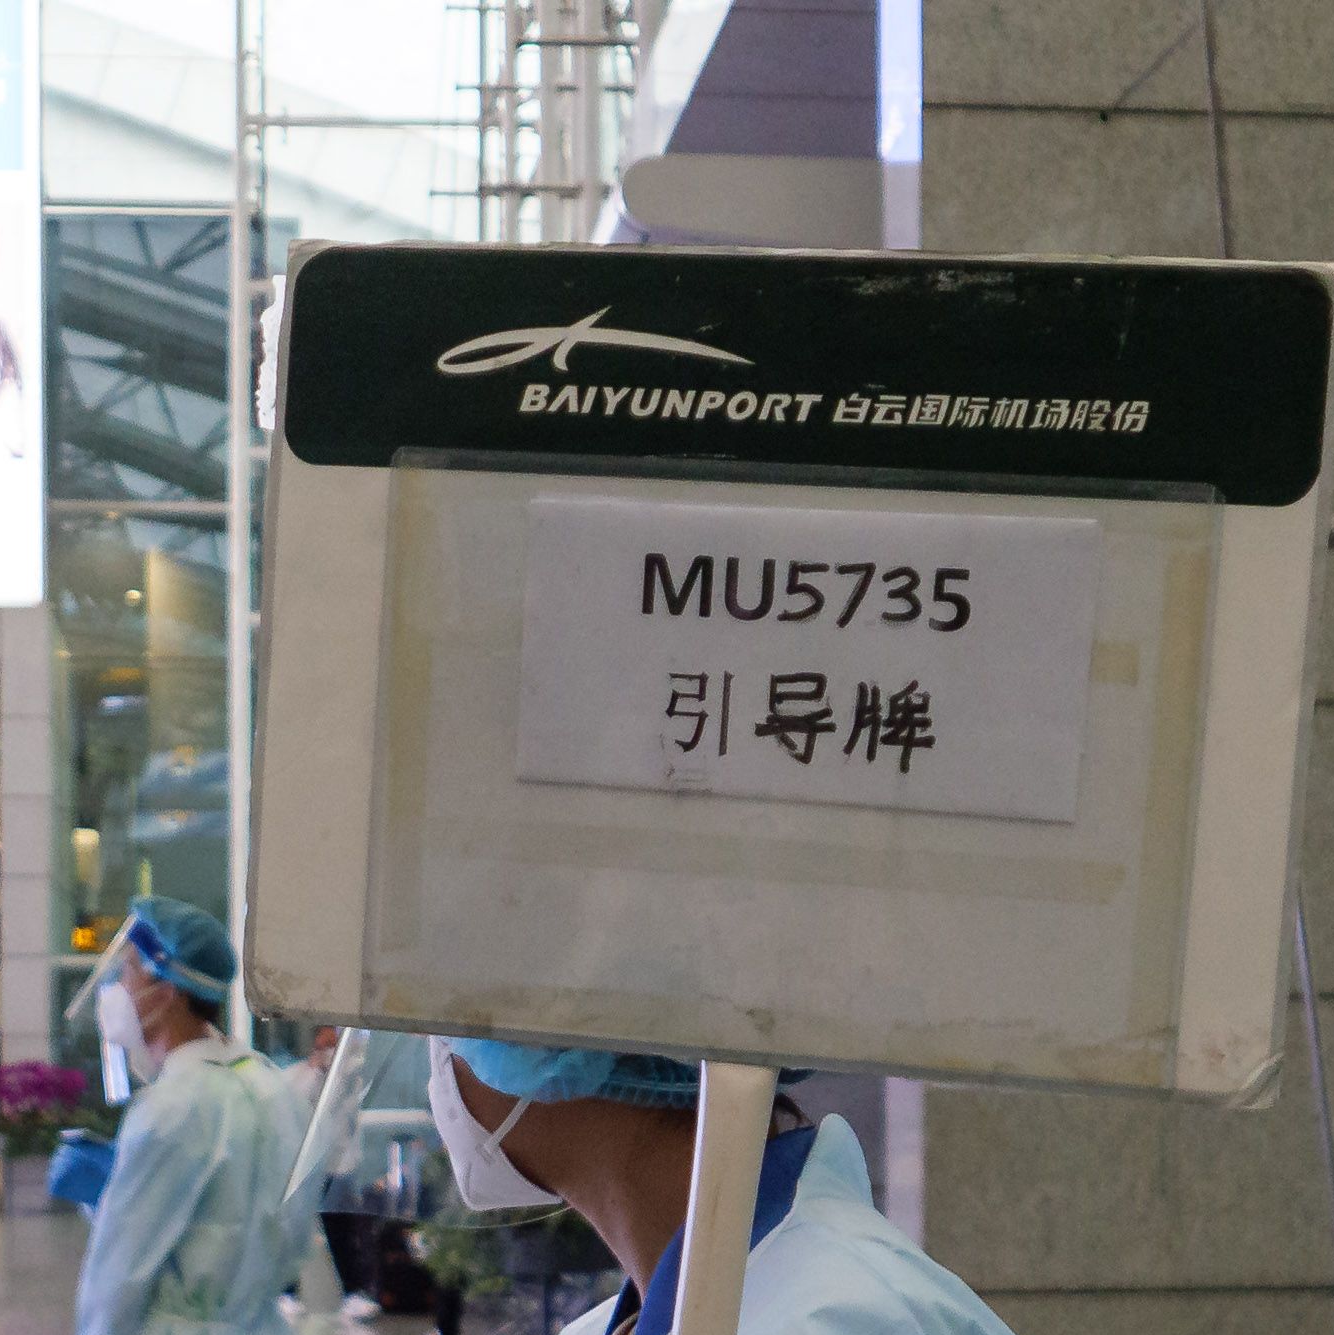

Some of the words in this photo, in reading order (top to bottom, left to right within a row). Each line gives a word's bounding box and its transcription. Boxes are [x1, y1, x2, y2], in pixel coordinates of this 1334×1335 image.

[519, 383, 823, 422] BAIYUNPORT
[832, 392, 1150, 432] 白云国际机场股份
[641, 552, 972, 633] MU5735
[665, 670, 937, 774] 引导牌
